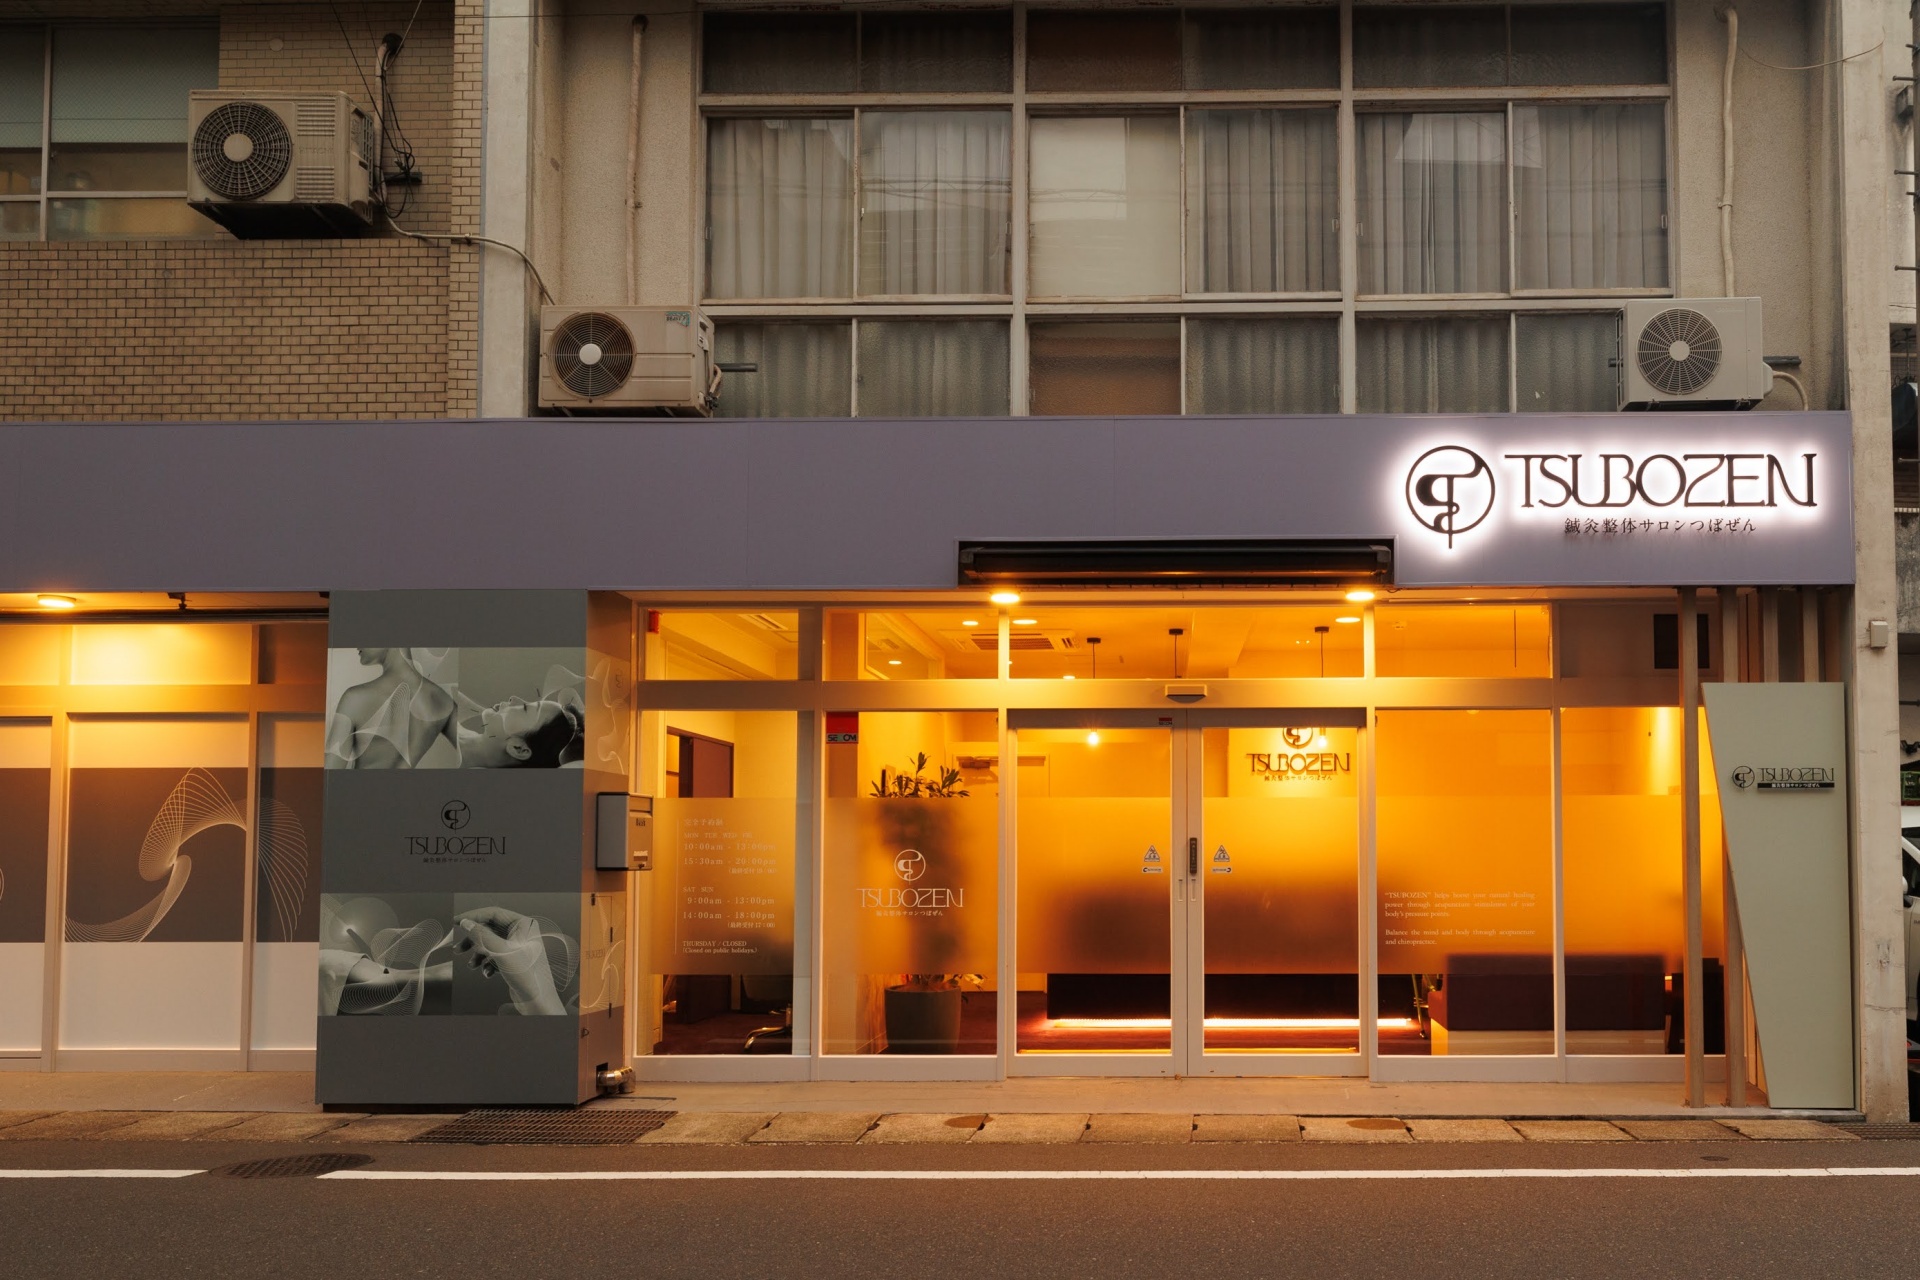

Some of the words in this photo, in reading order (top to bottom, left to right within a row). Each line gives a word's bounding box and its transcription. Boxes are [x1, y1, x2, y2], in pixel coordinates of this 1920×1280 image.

[1505, 453, 1817, 507] TSUBOZEN
[1563, 517, 1757, 534] 鍼灸整体サロンつぼぜん
[1246, 752, 1350, 773] TSUBOZEN
[1757, 767, 1835, 782] TSUBOZEN
[404, 836, 506, 855] TSUBOZEN
[684, 843, 723, 851] 10:00am
[736, 843, 776, 852] 13:00pm
[684, 857, 723, 865] 15:30am
[735, 857, 776, 866] 20:00pm
[856, 888, 964, 908] TSUBOZEN
[1434, 892, 1450, 900] helps
[687, 896, 722, 904] 9:00am
[735, 896, 775, 906] 13:00pm
[1385, 902, 1404, 910] power
[1407, 901, 1431, 910] through
[683, 911, 722, 919] 14:00am
[735, 911, 775, 920] 18:00pm
[1455, 929, 1470, 937] body
[1472, 929, 1496, 938] through
[713, 947, 730, 955] public
